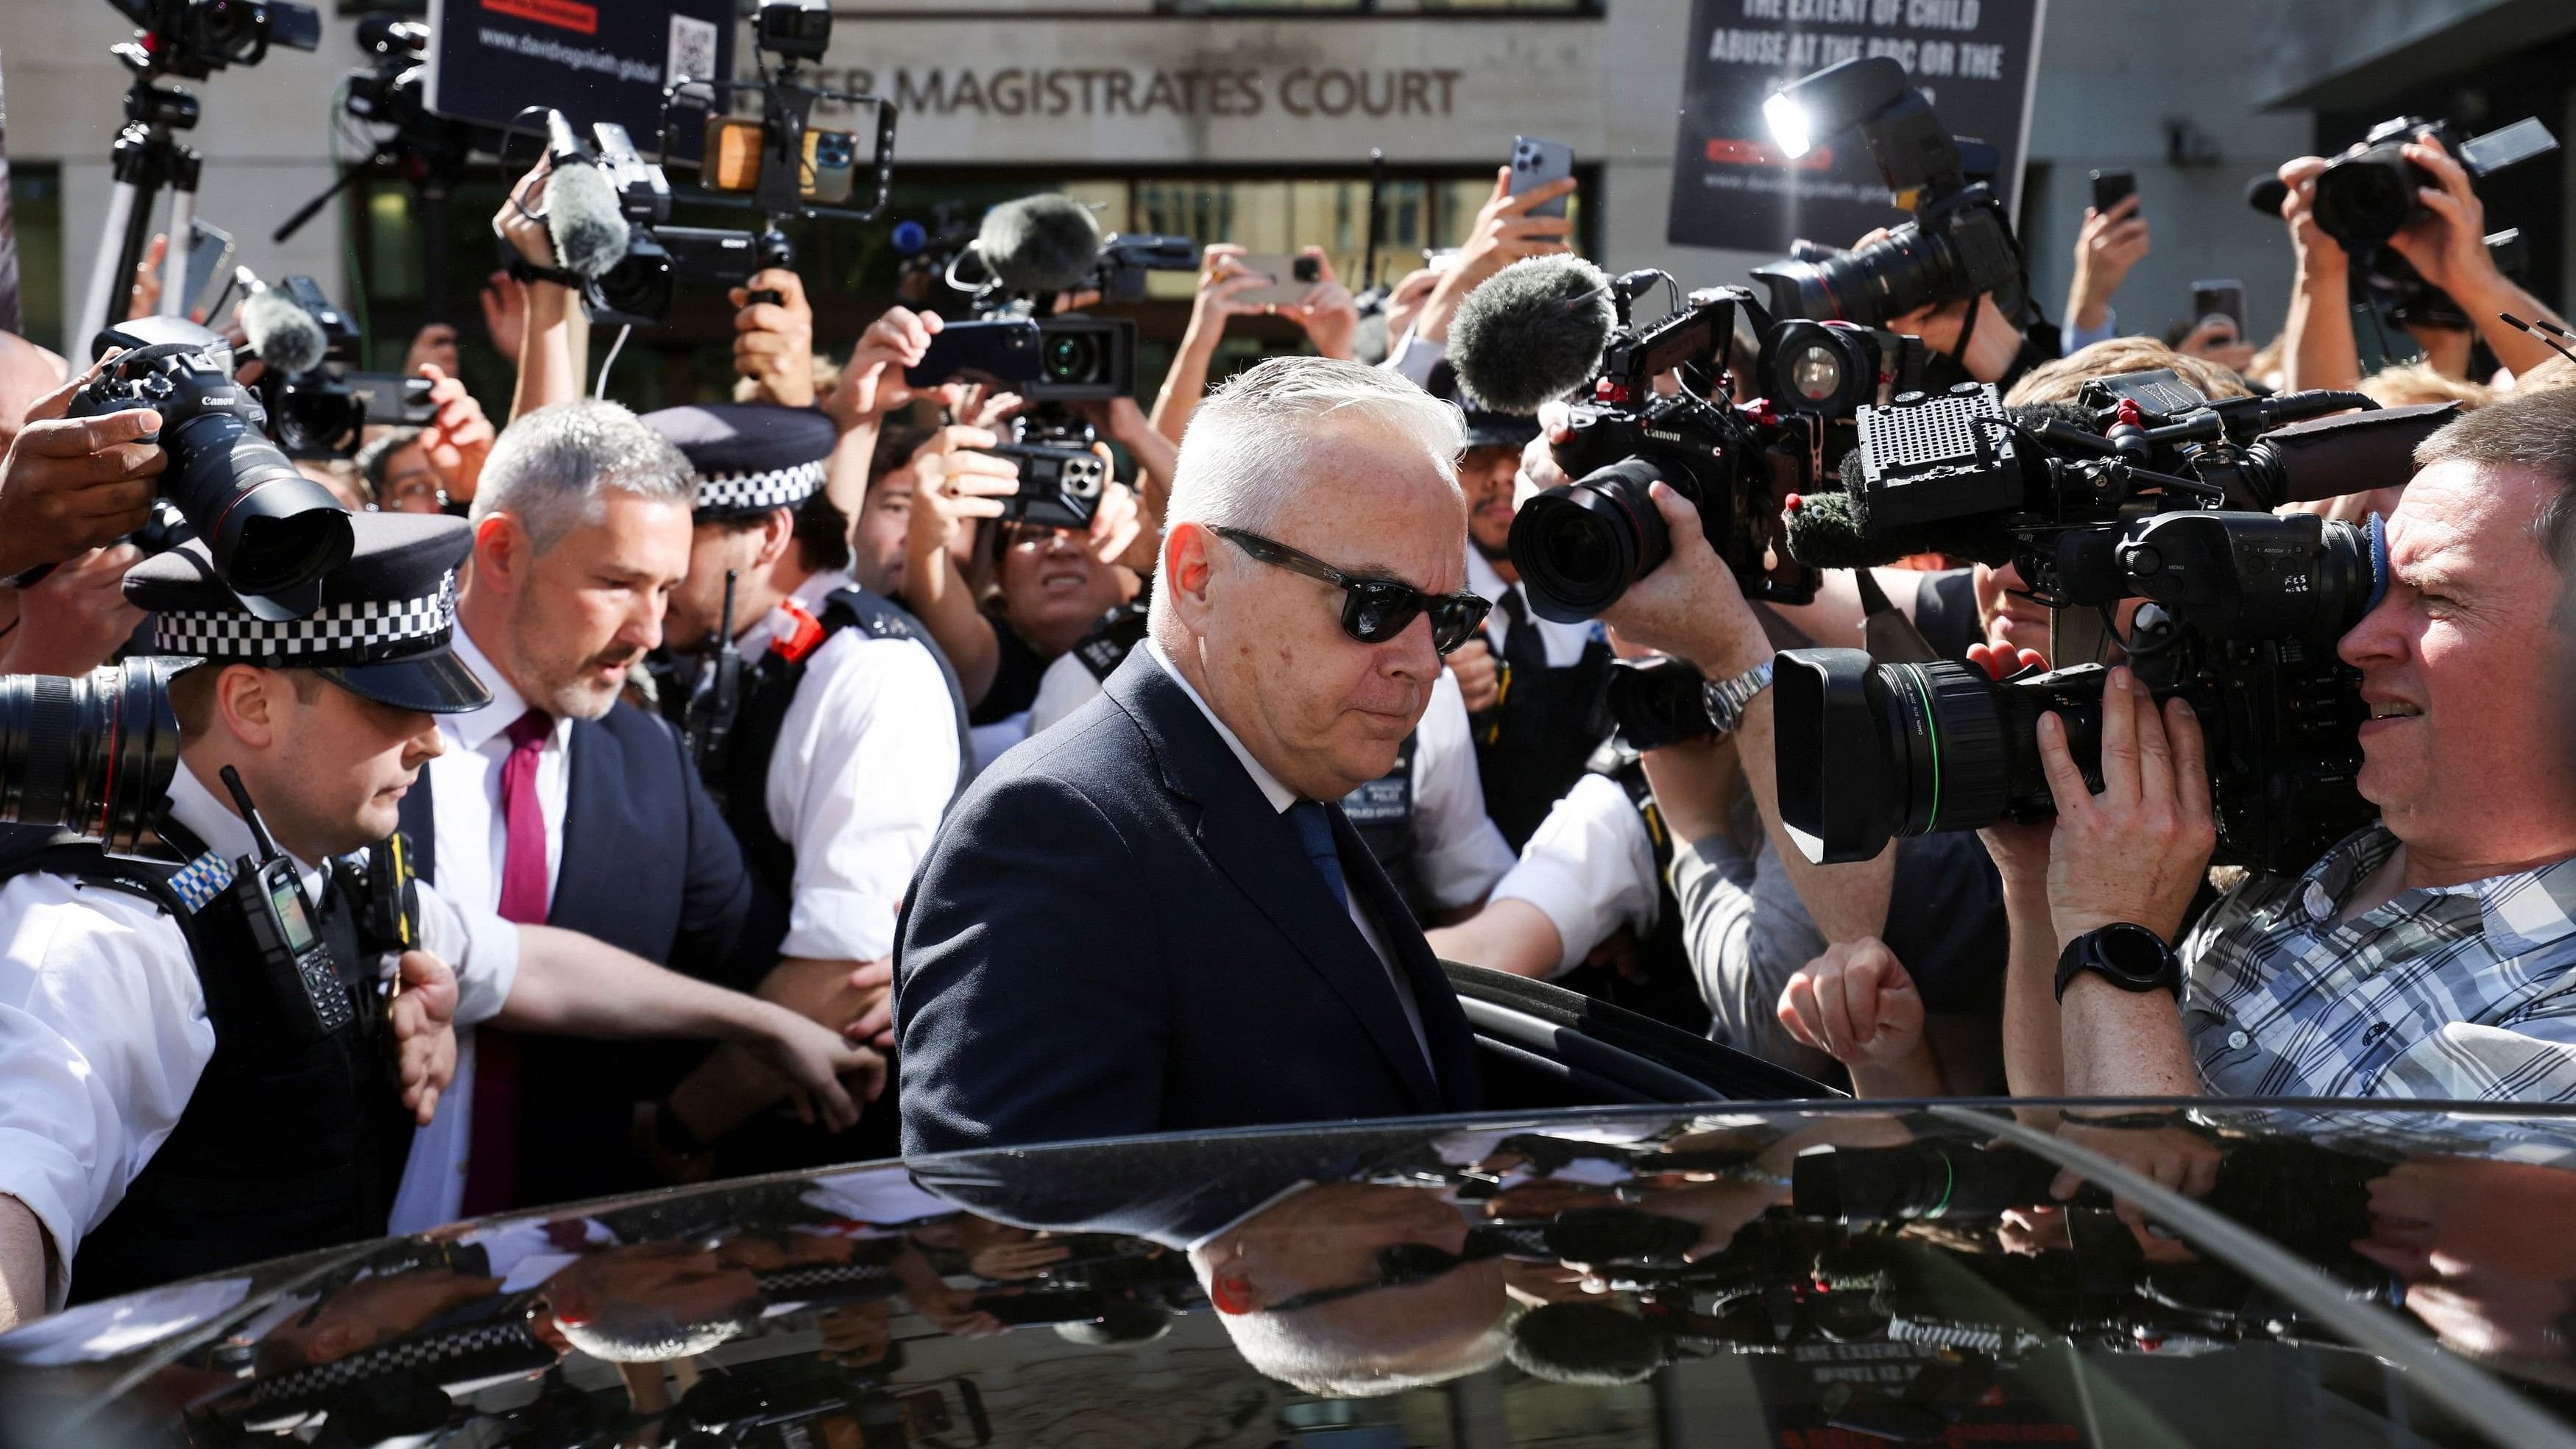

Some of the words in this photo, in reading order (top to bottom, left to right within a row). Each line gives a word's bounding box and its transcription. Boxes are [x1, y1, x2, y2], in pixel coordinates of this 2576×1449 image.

[1869, 0, 1903, 26] OF
[1906, 0, 1981, 30] CHILD
[1708, 28, 1784, 64] ABUSE
[1785, 32, 1818, 68] AT
[1820, 34, 1864, 66] THE
[1917, 40, 1956, 76] OR
[1958, 44, 2004, 80] THE
[896, 68, 1265, 117] MAGISTRATES
[1280, 68, 1461, 117] COURT
[201, 396, 235, 406] Canon
[1643, 428, 1681, 442] Canon
